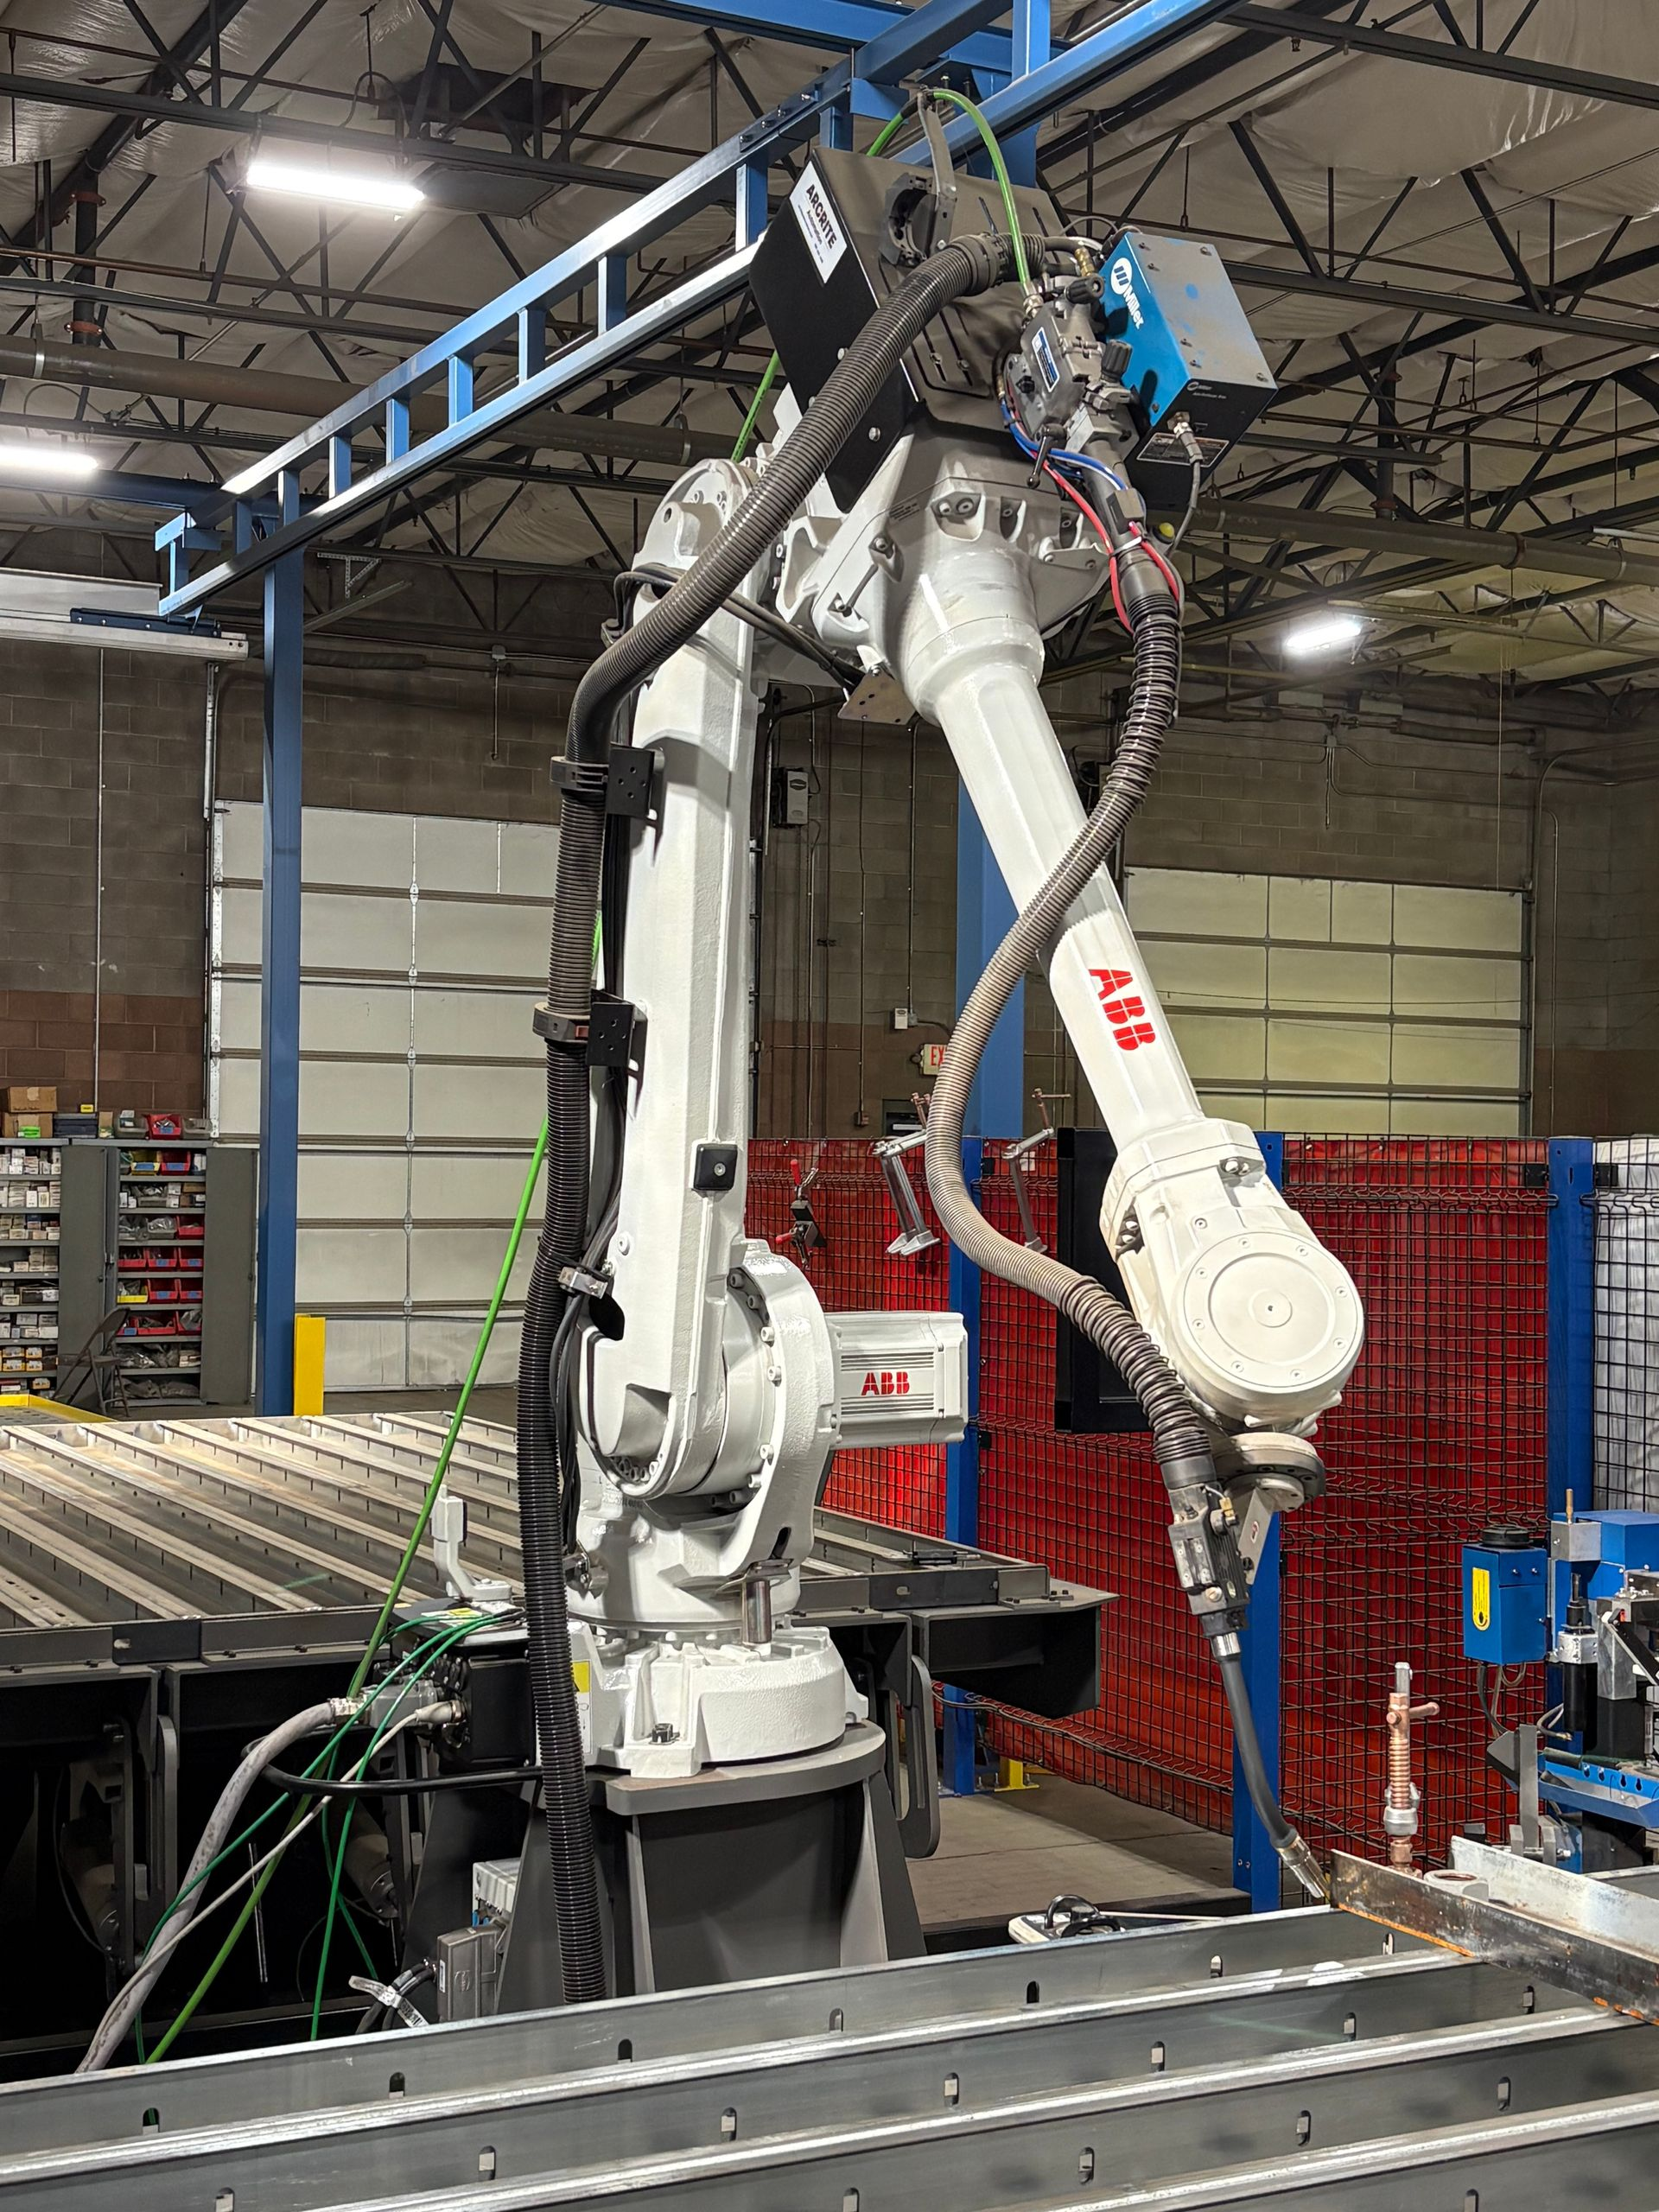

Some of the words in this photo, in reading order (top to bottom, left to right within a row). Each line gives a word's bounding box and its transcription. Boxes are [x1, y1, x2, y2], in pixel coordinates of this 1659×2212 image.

[806, 184, 836, 249] ARCRITE
[1123, 284, 1144, 329] Miller
[1088, 969, 1156, 1051] ABB
[931, 1046, 947, 1066] EX
[861, 1371, 910, 1395] ABB
